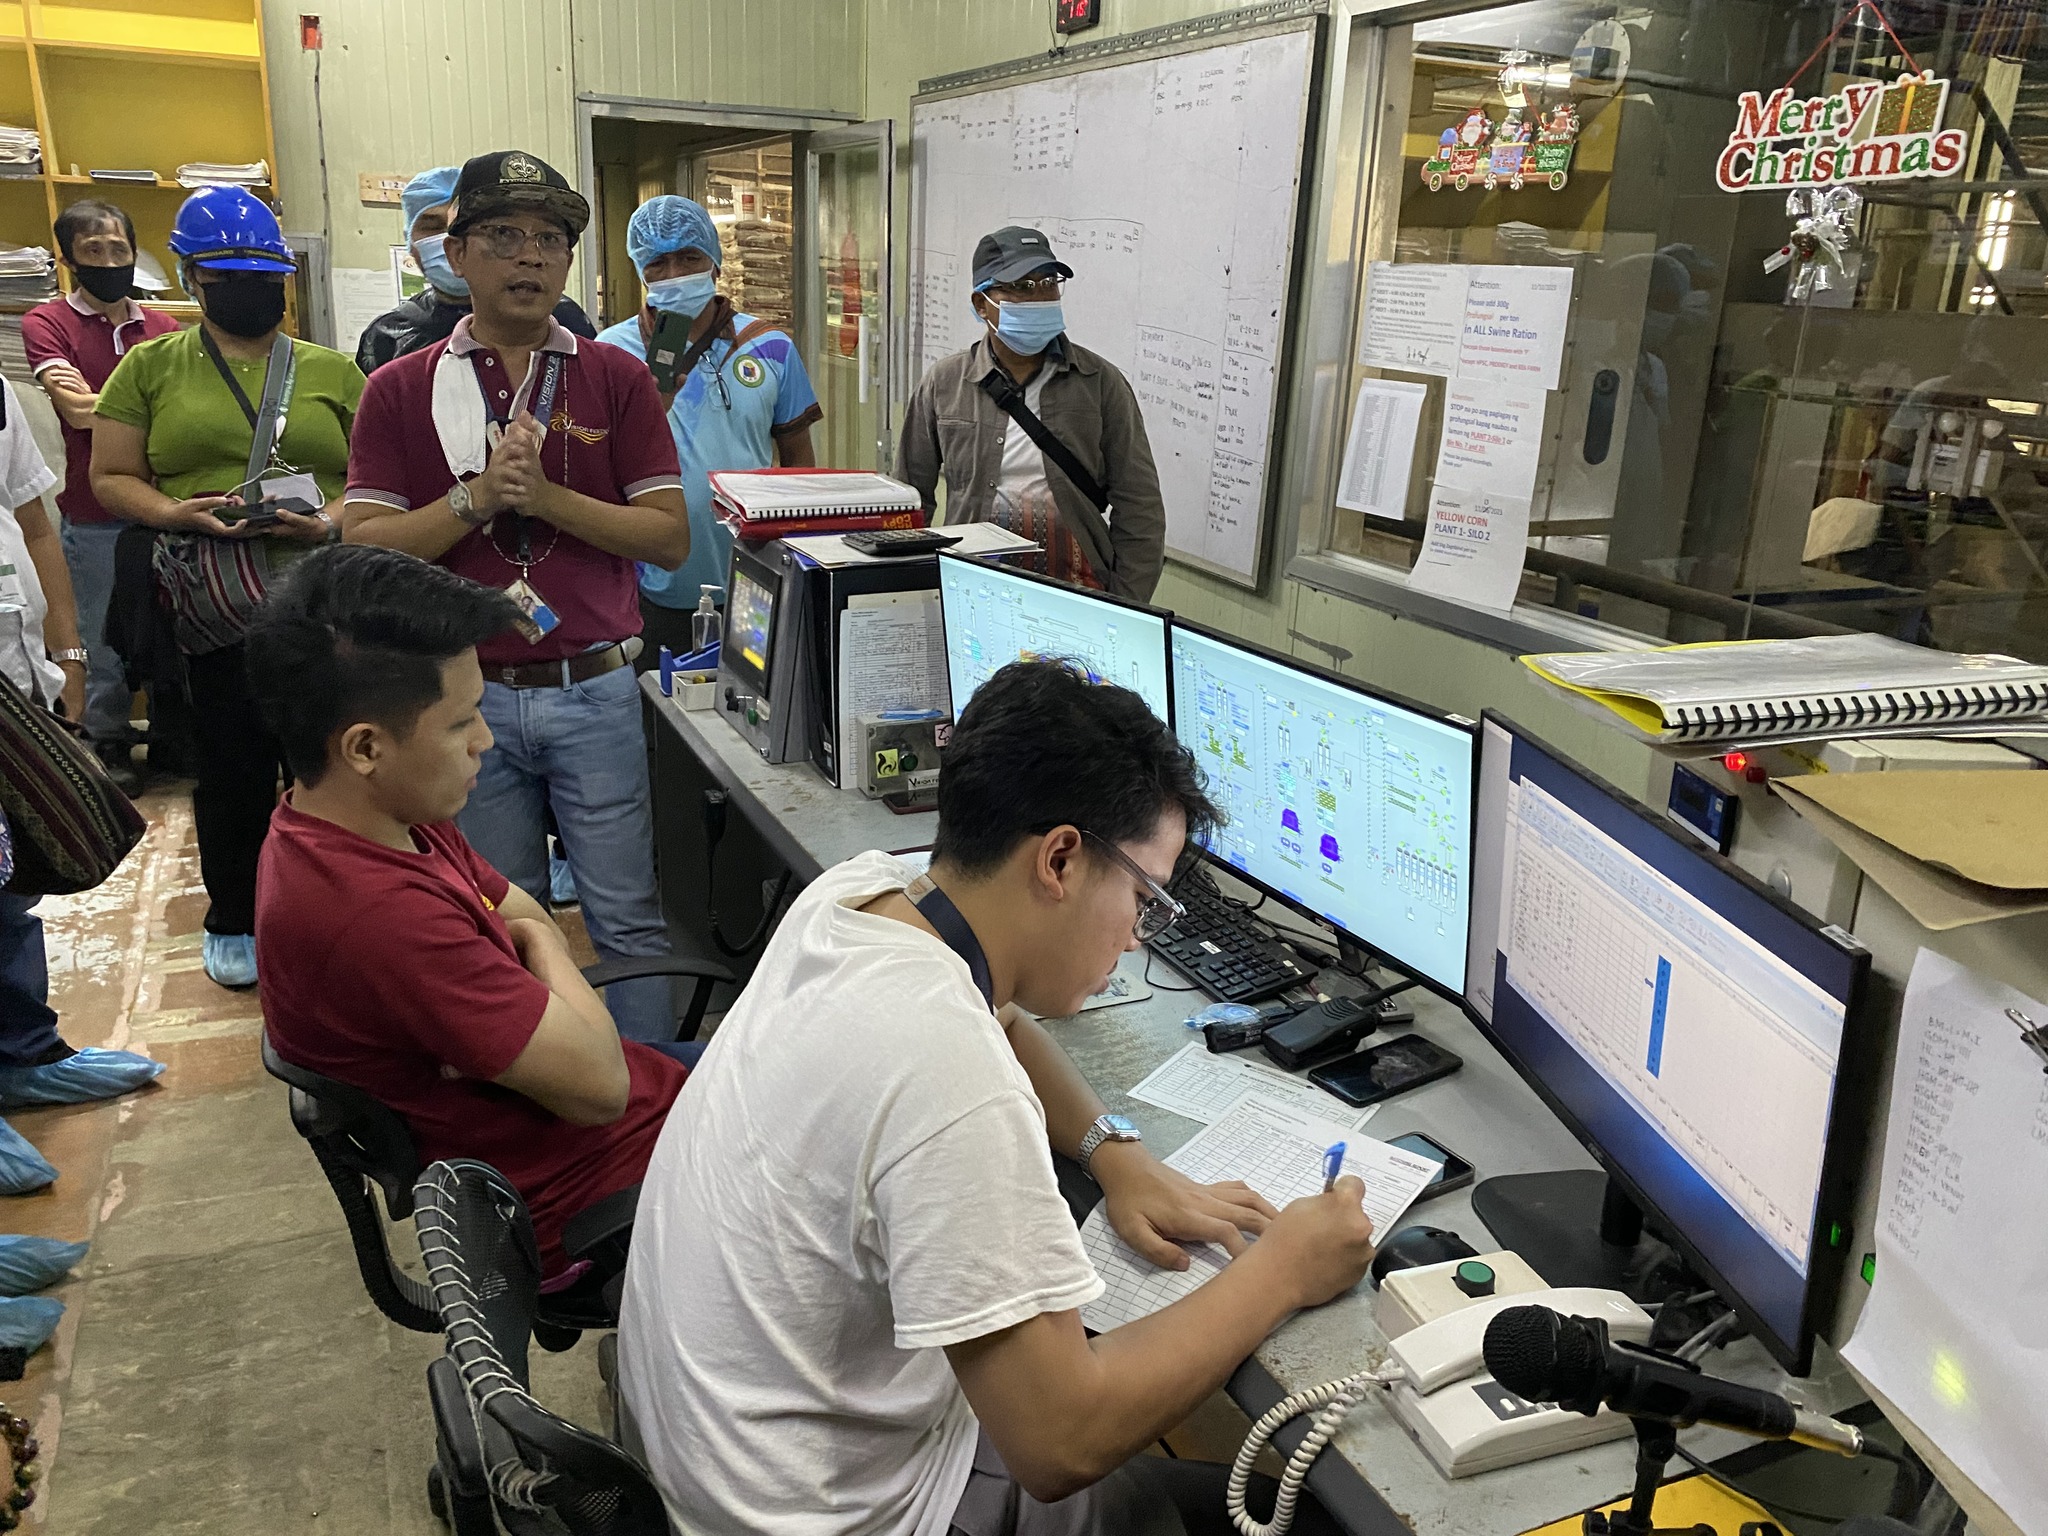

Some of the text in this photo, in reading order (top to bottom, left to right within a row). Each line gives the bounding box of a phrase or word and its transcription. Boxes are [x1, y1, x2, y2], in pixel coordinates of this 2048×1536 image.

[1732, 85, 1879, 140] Merry
[1719, 133, 1962, 188] Christmas
[1470, 280, 1501, 290] Attention:
[1496, 301, 1510, 309] 300g
[1464, 324, 1537, 340] in ALL Swine Ration
[540, 366, 554, 405] VISION
[1471, 431, 1486, 440] PLANT
[1437, 499, 1461, 508] Attention:
[1436, 510, 1488, 527] YELLOW CORN
[1435, 523, 1490, 540] PLANT 1- SILO 2
